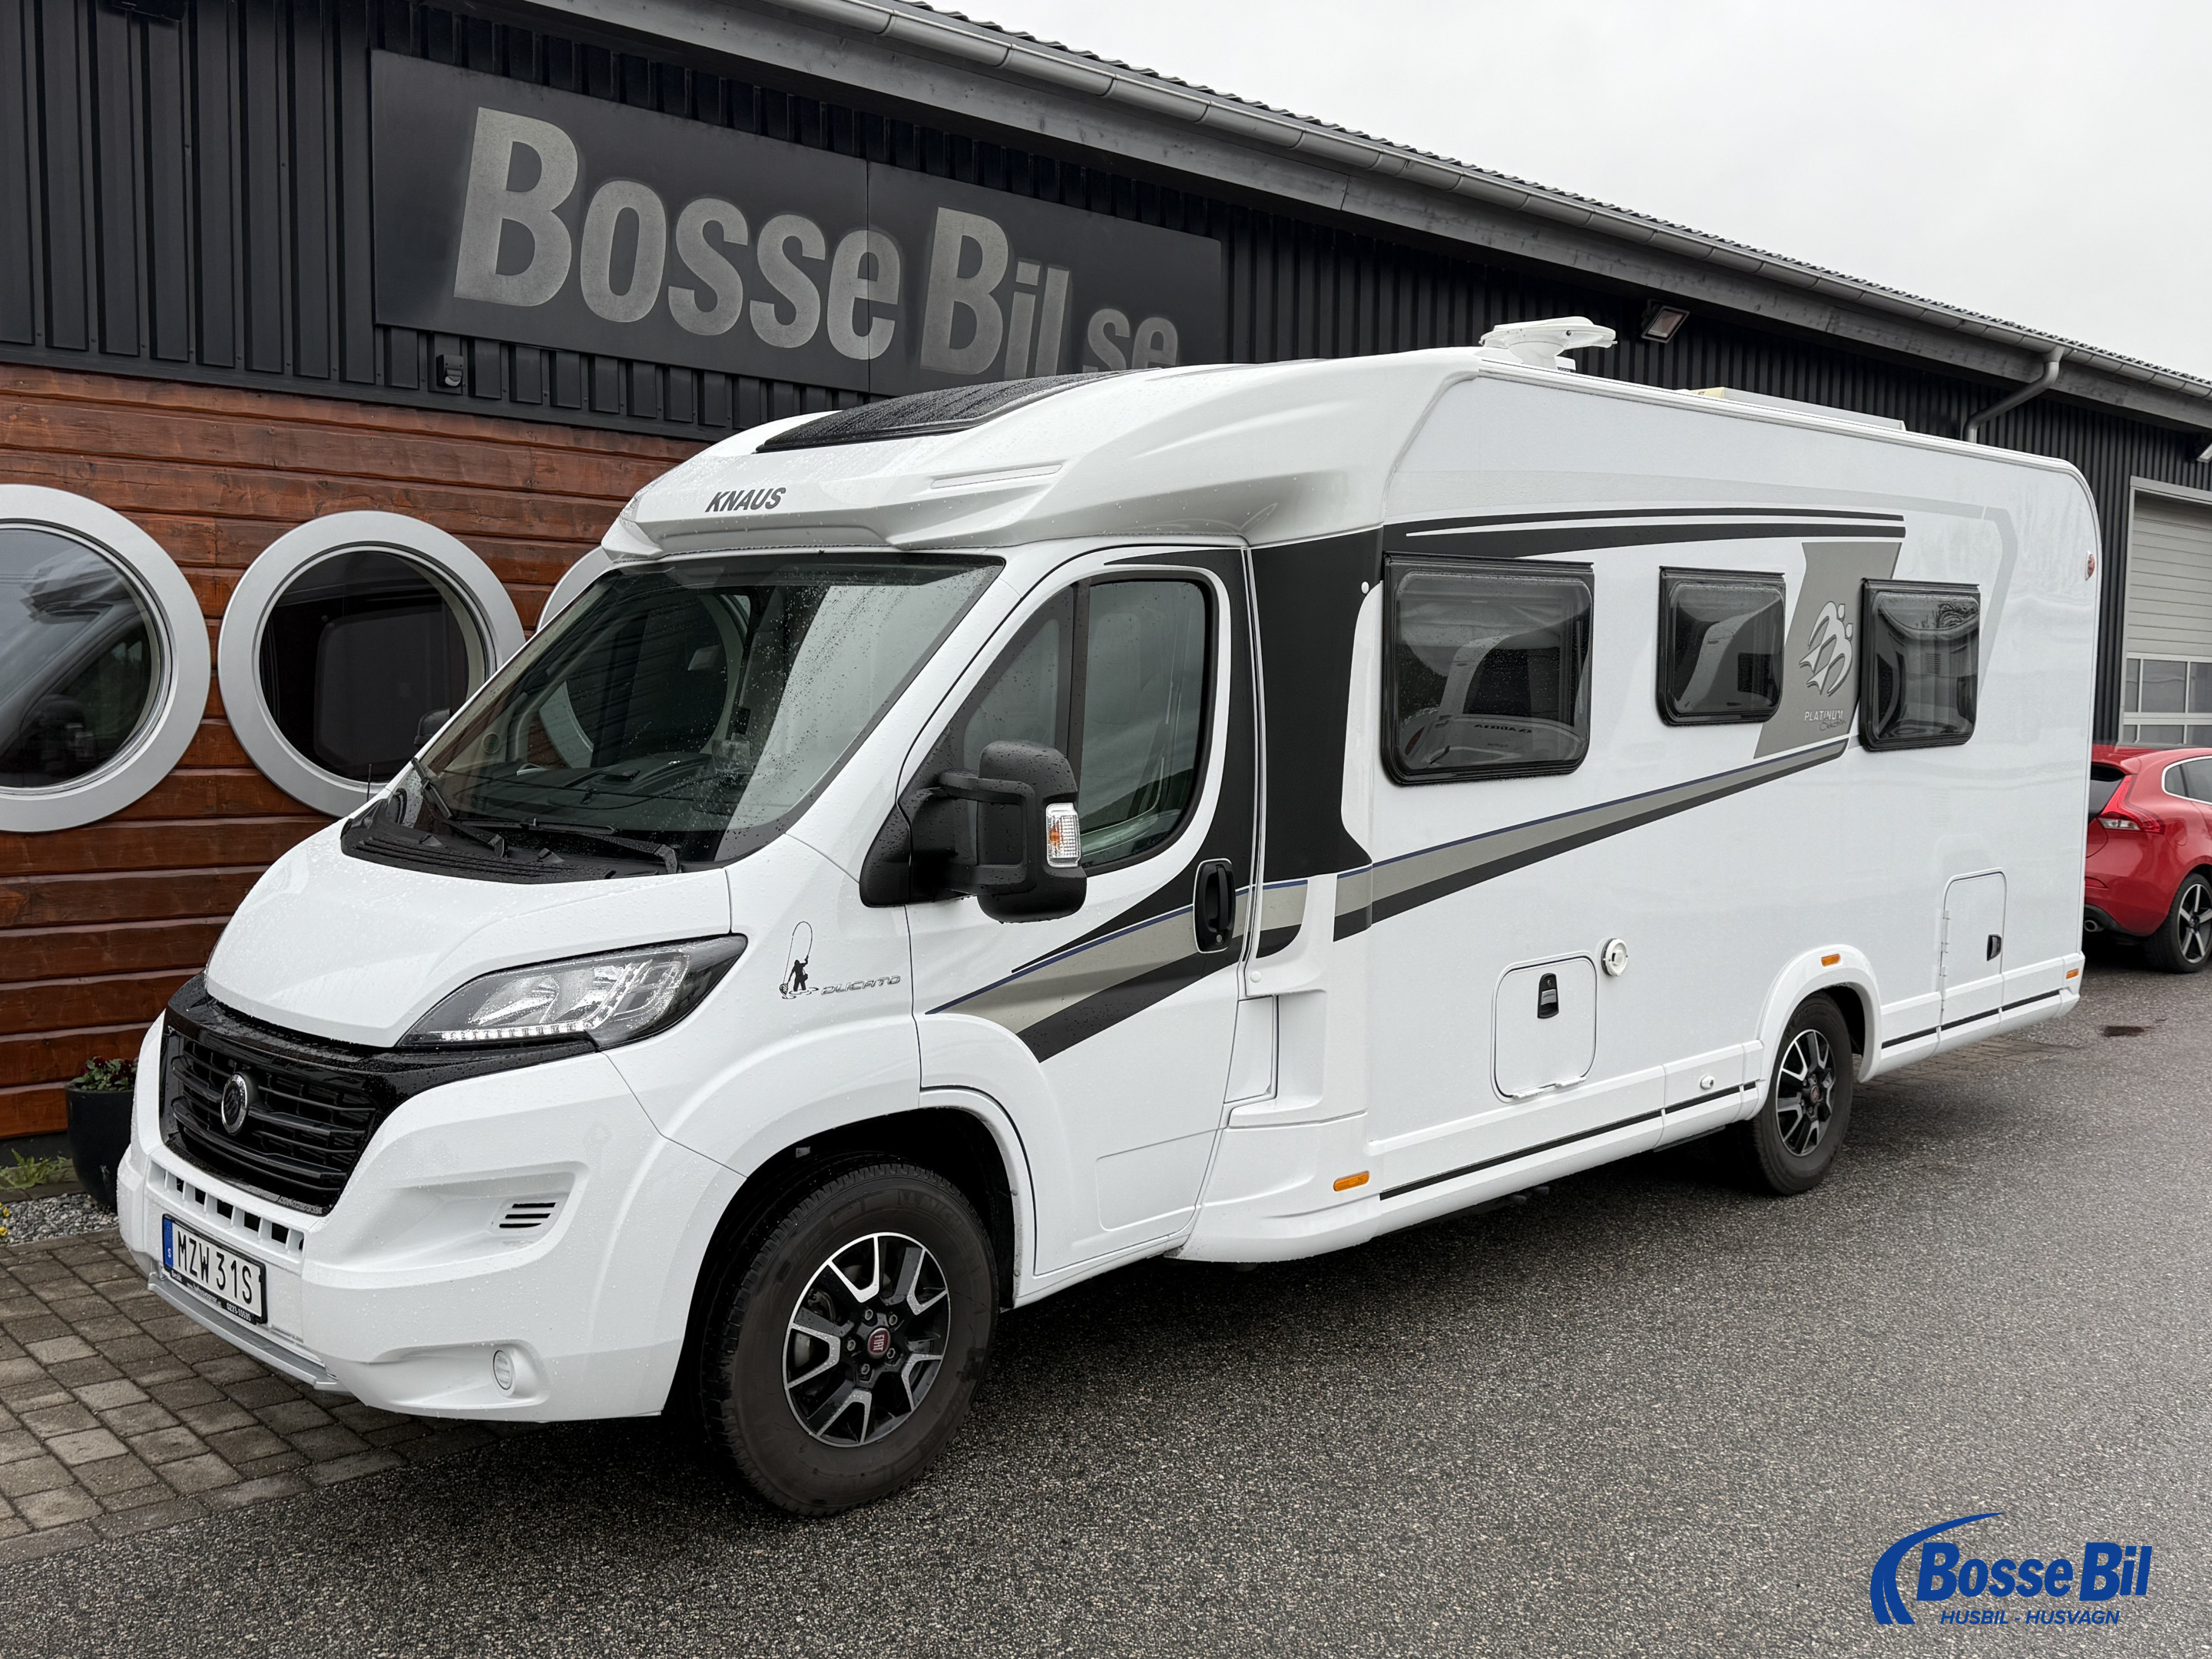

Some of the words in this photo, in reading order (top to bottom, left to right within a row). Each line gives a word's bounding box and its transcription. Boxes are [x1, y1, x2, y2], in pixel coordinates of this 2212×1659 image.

[454, 107, 901, 360] Bosse
[921, 207, 1070, 379] Bil
[704, 487, 787, 513] KNAUS
[1803, 709, 1844, 721] PLATINUM
[820, 975, 902, 995] DUCATO
[177, 1230, 210, 1284] MZW
[216, 1251, 253, 1304] 31S
[873, 1334, 885, 1351] FIAT
